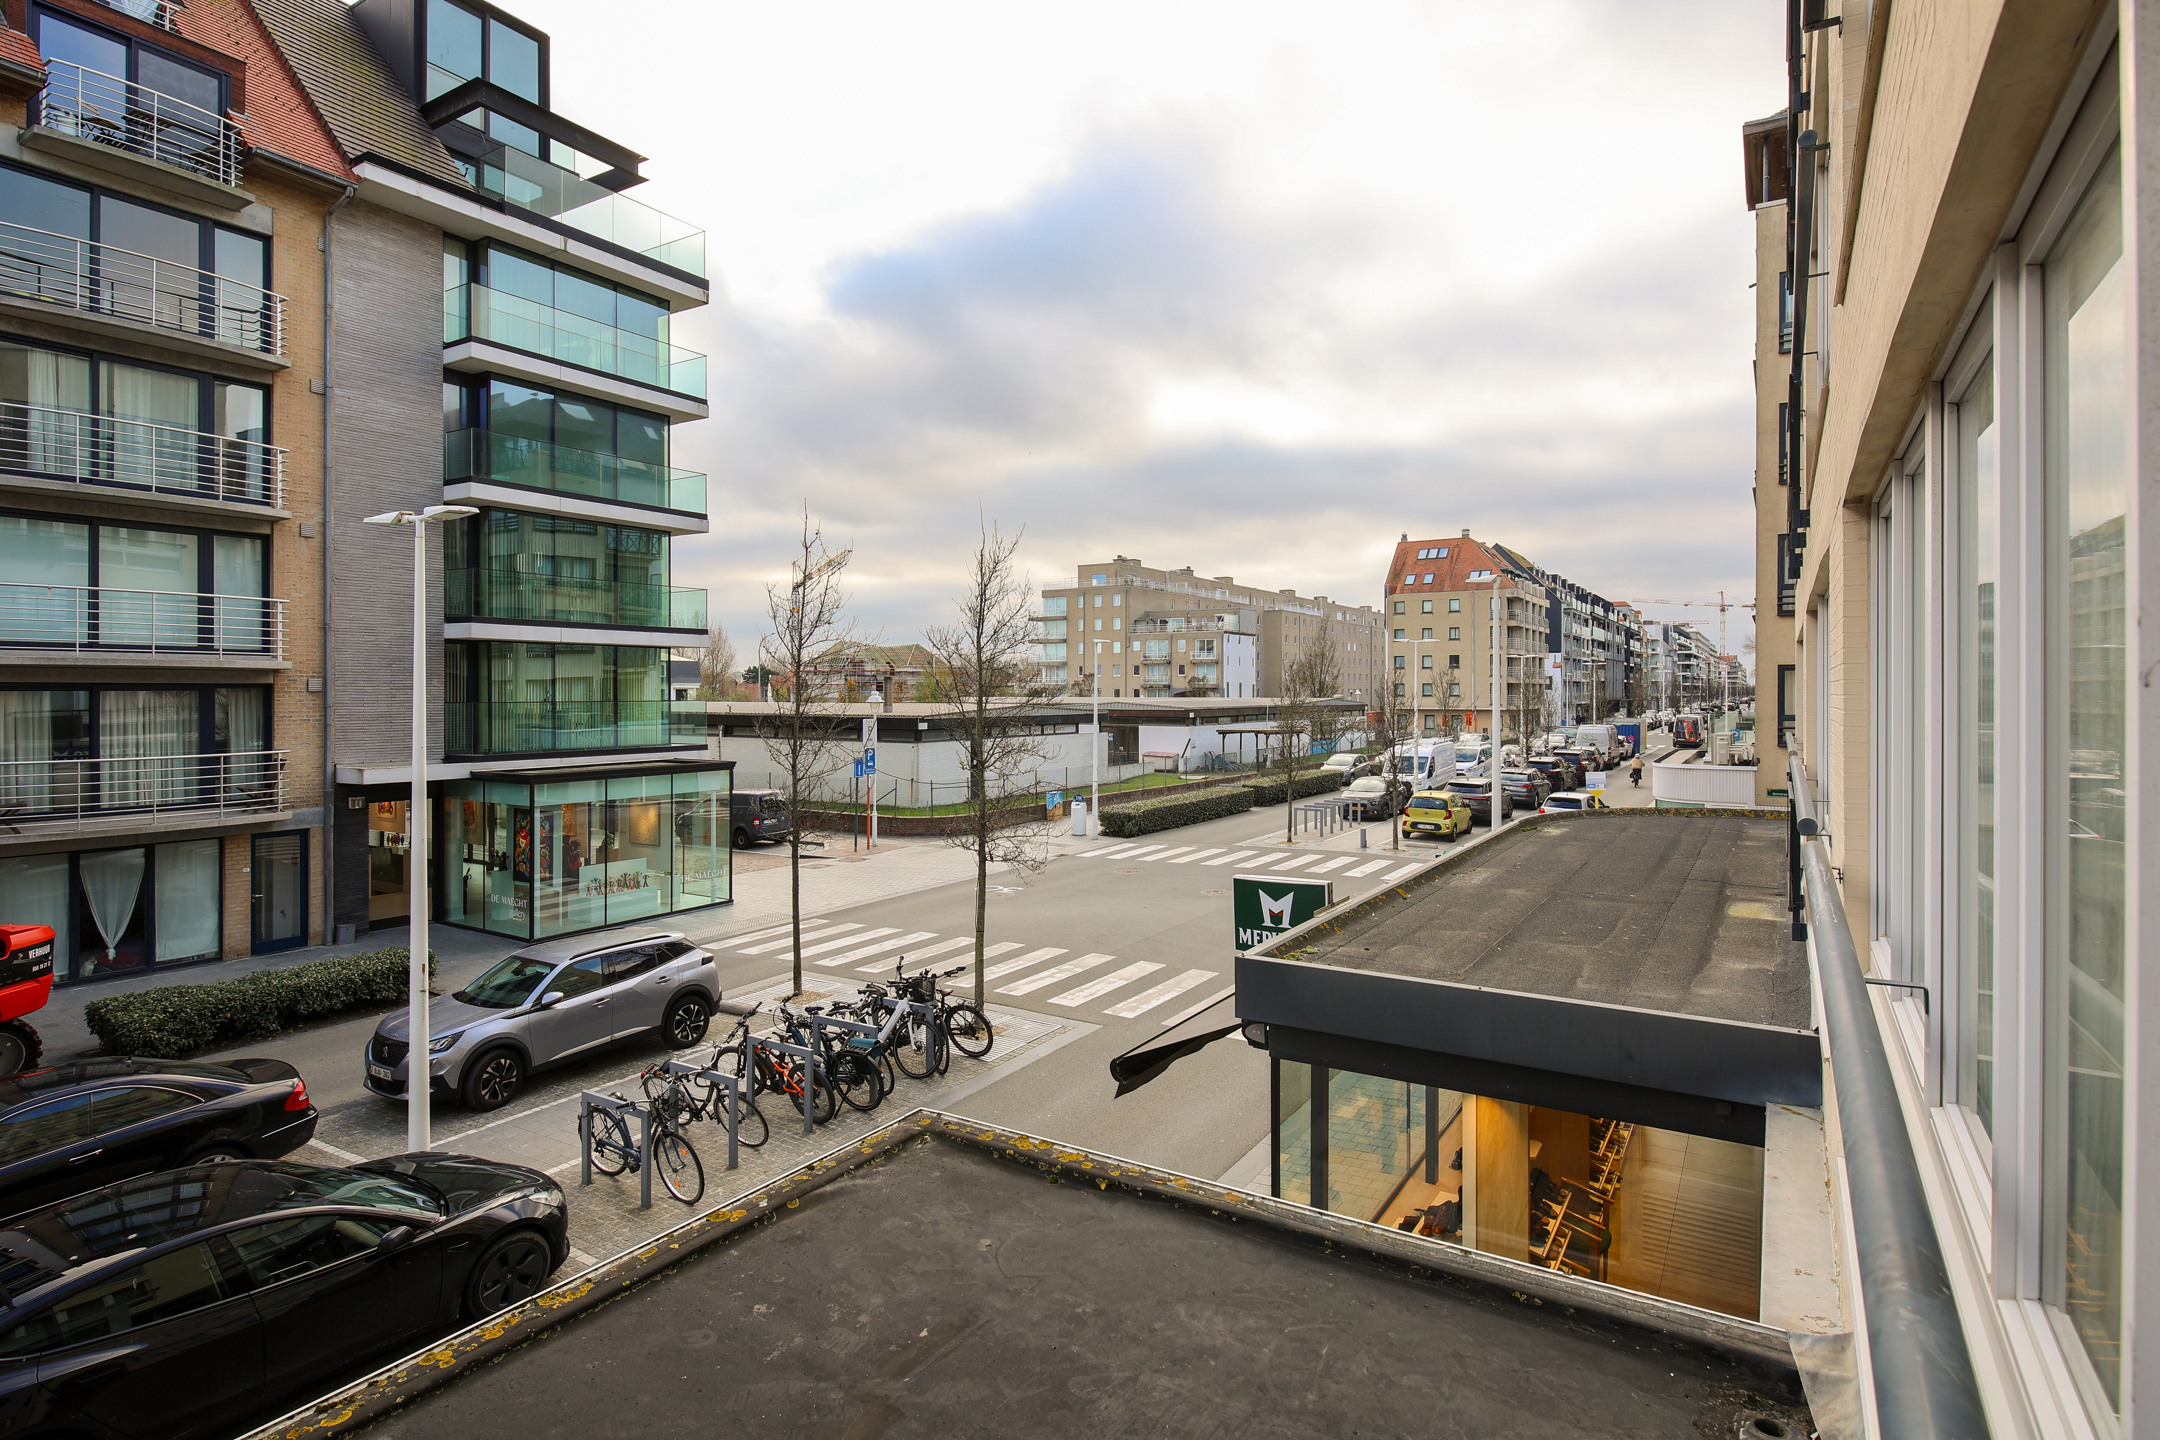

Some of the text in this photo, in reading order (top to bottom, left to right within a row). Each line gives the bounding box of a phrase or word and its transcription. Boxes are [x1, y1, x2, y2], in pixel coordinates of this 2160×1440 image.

[867, 749, 874, 760] P
[490, 893, 500, 904] DE
[28, 944, 51, 960] VERHUUR
